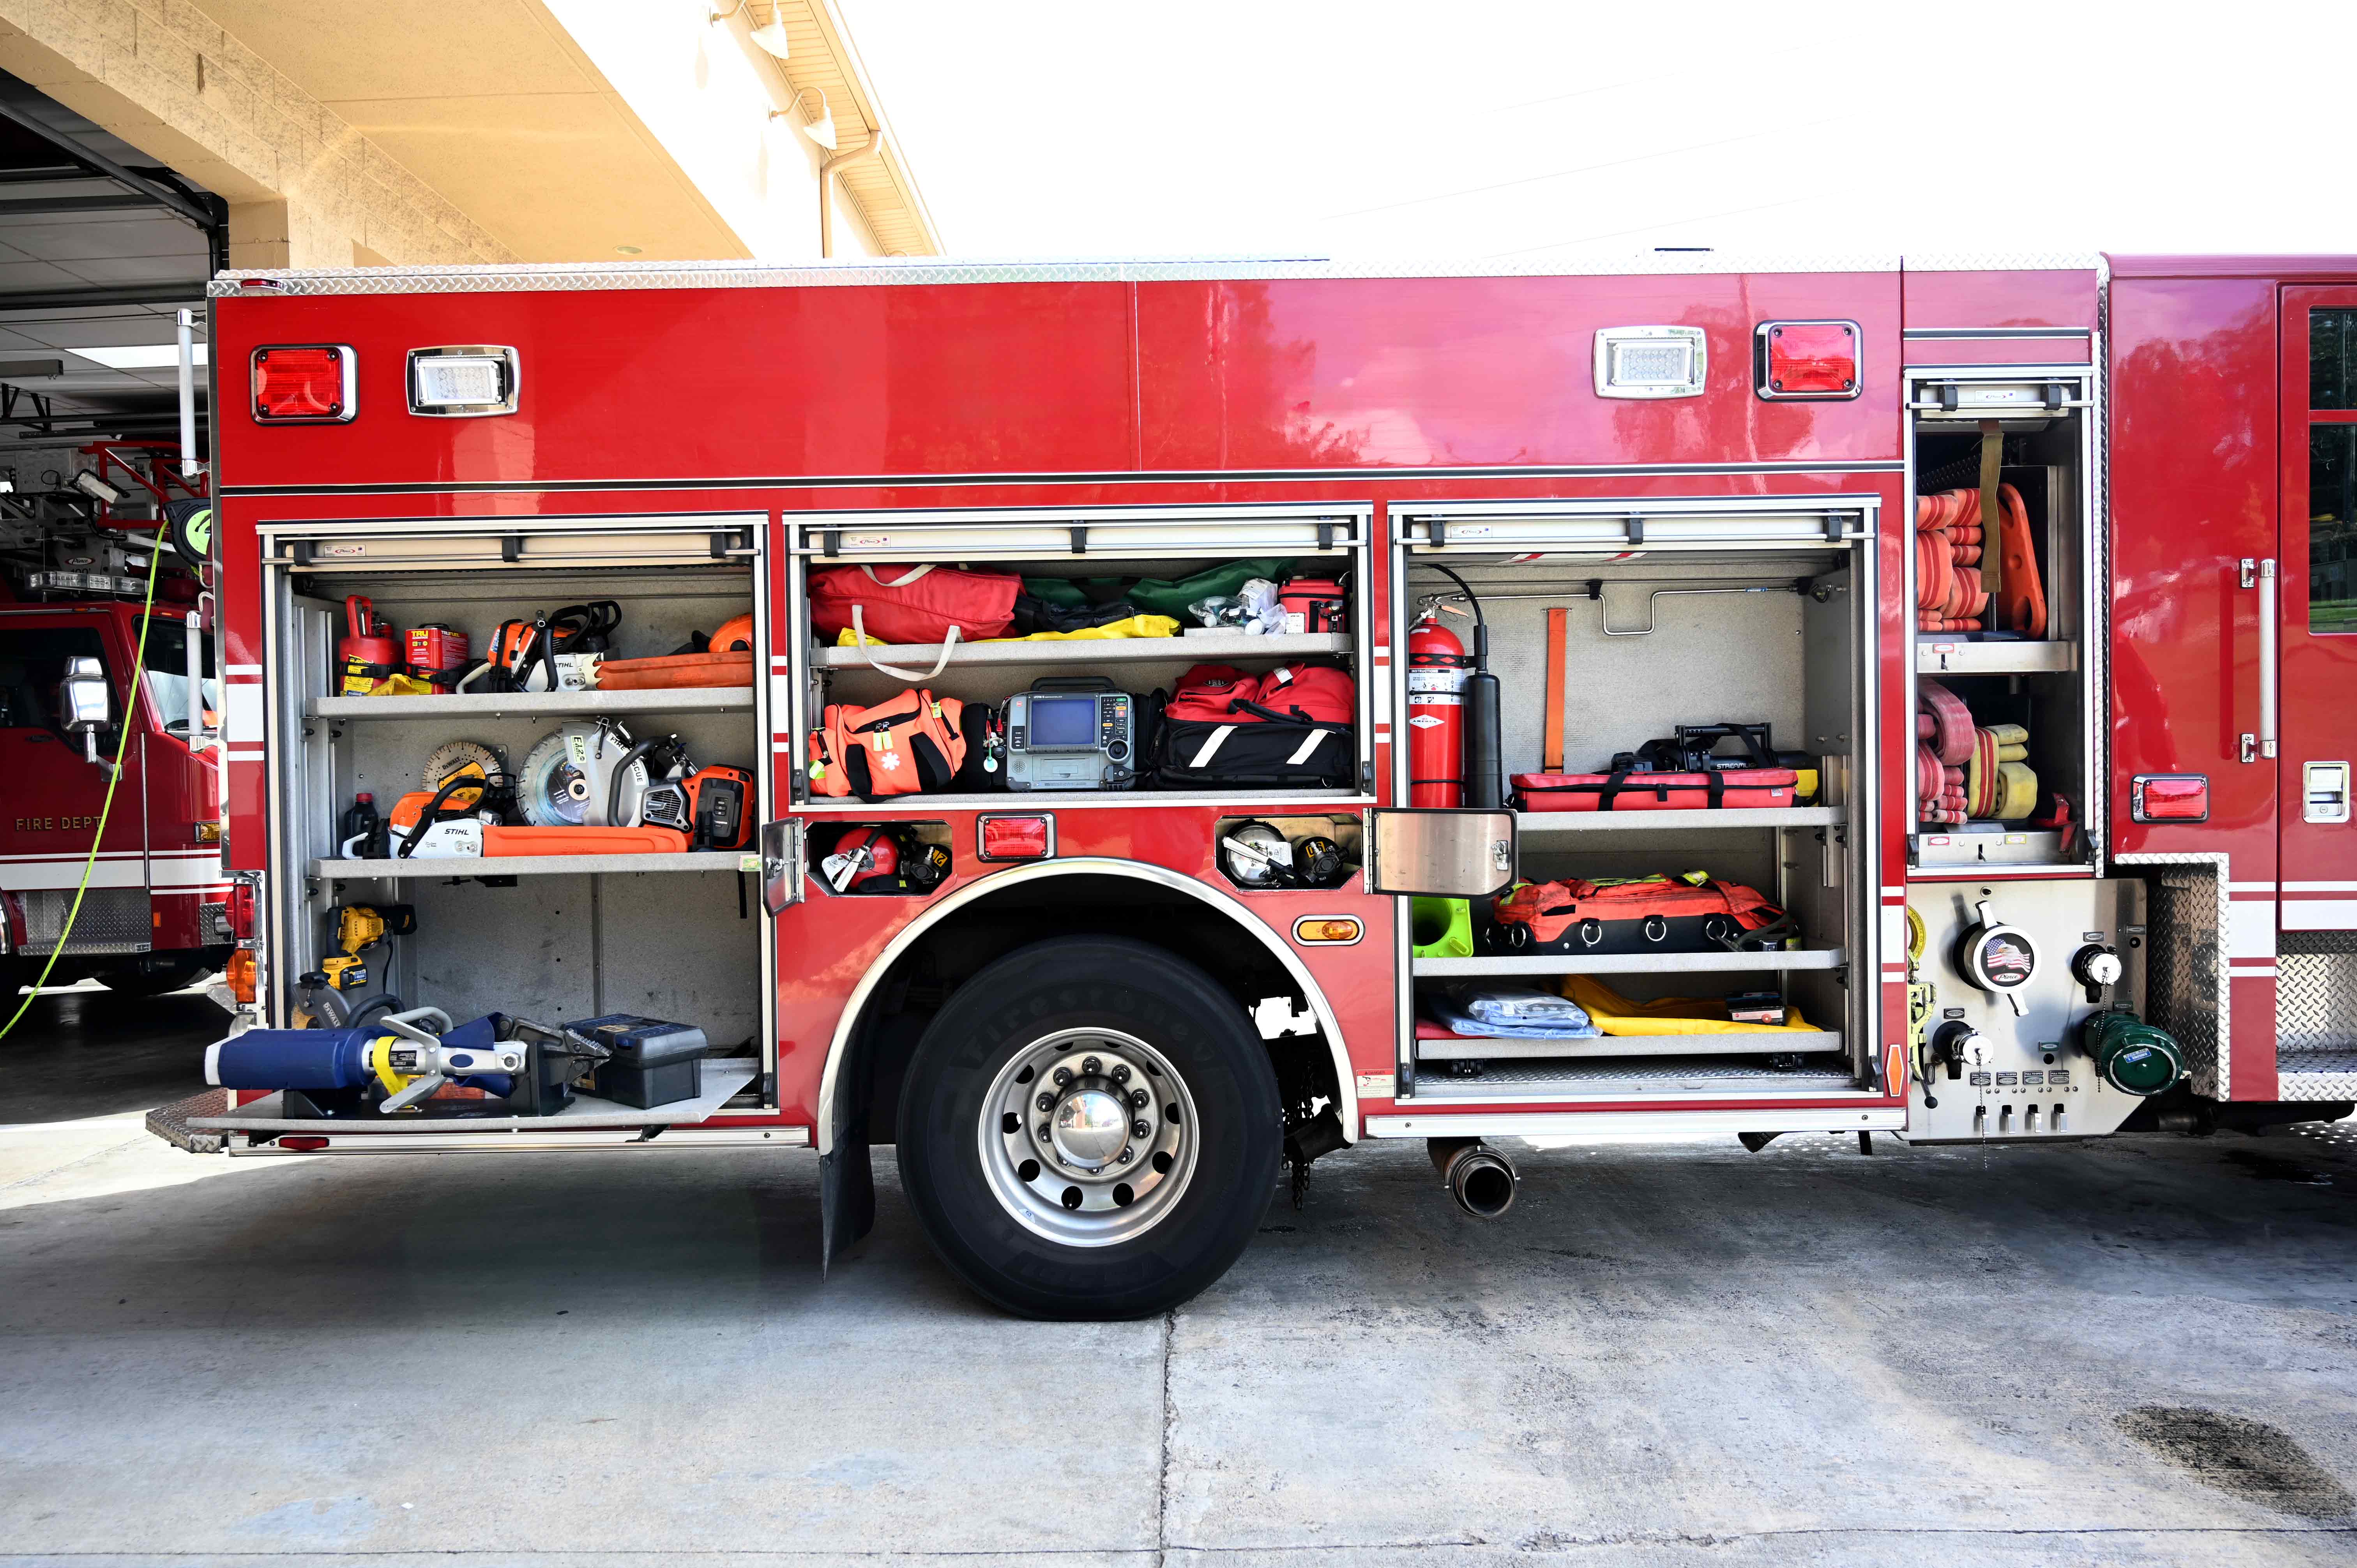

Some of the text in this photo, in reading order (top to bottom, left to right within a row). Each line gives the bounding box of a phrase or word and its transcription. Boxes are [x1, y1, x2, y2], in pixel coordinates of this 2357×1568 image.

[610, 736, 625, 751] FIRE
[16, 818, 53, 830] FIRE
[323, 1002, 341, 1028] DEWALT
